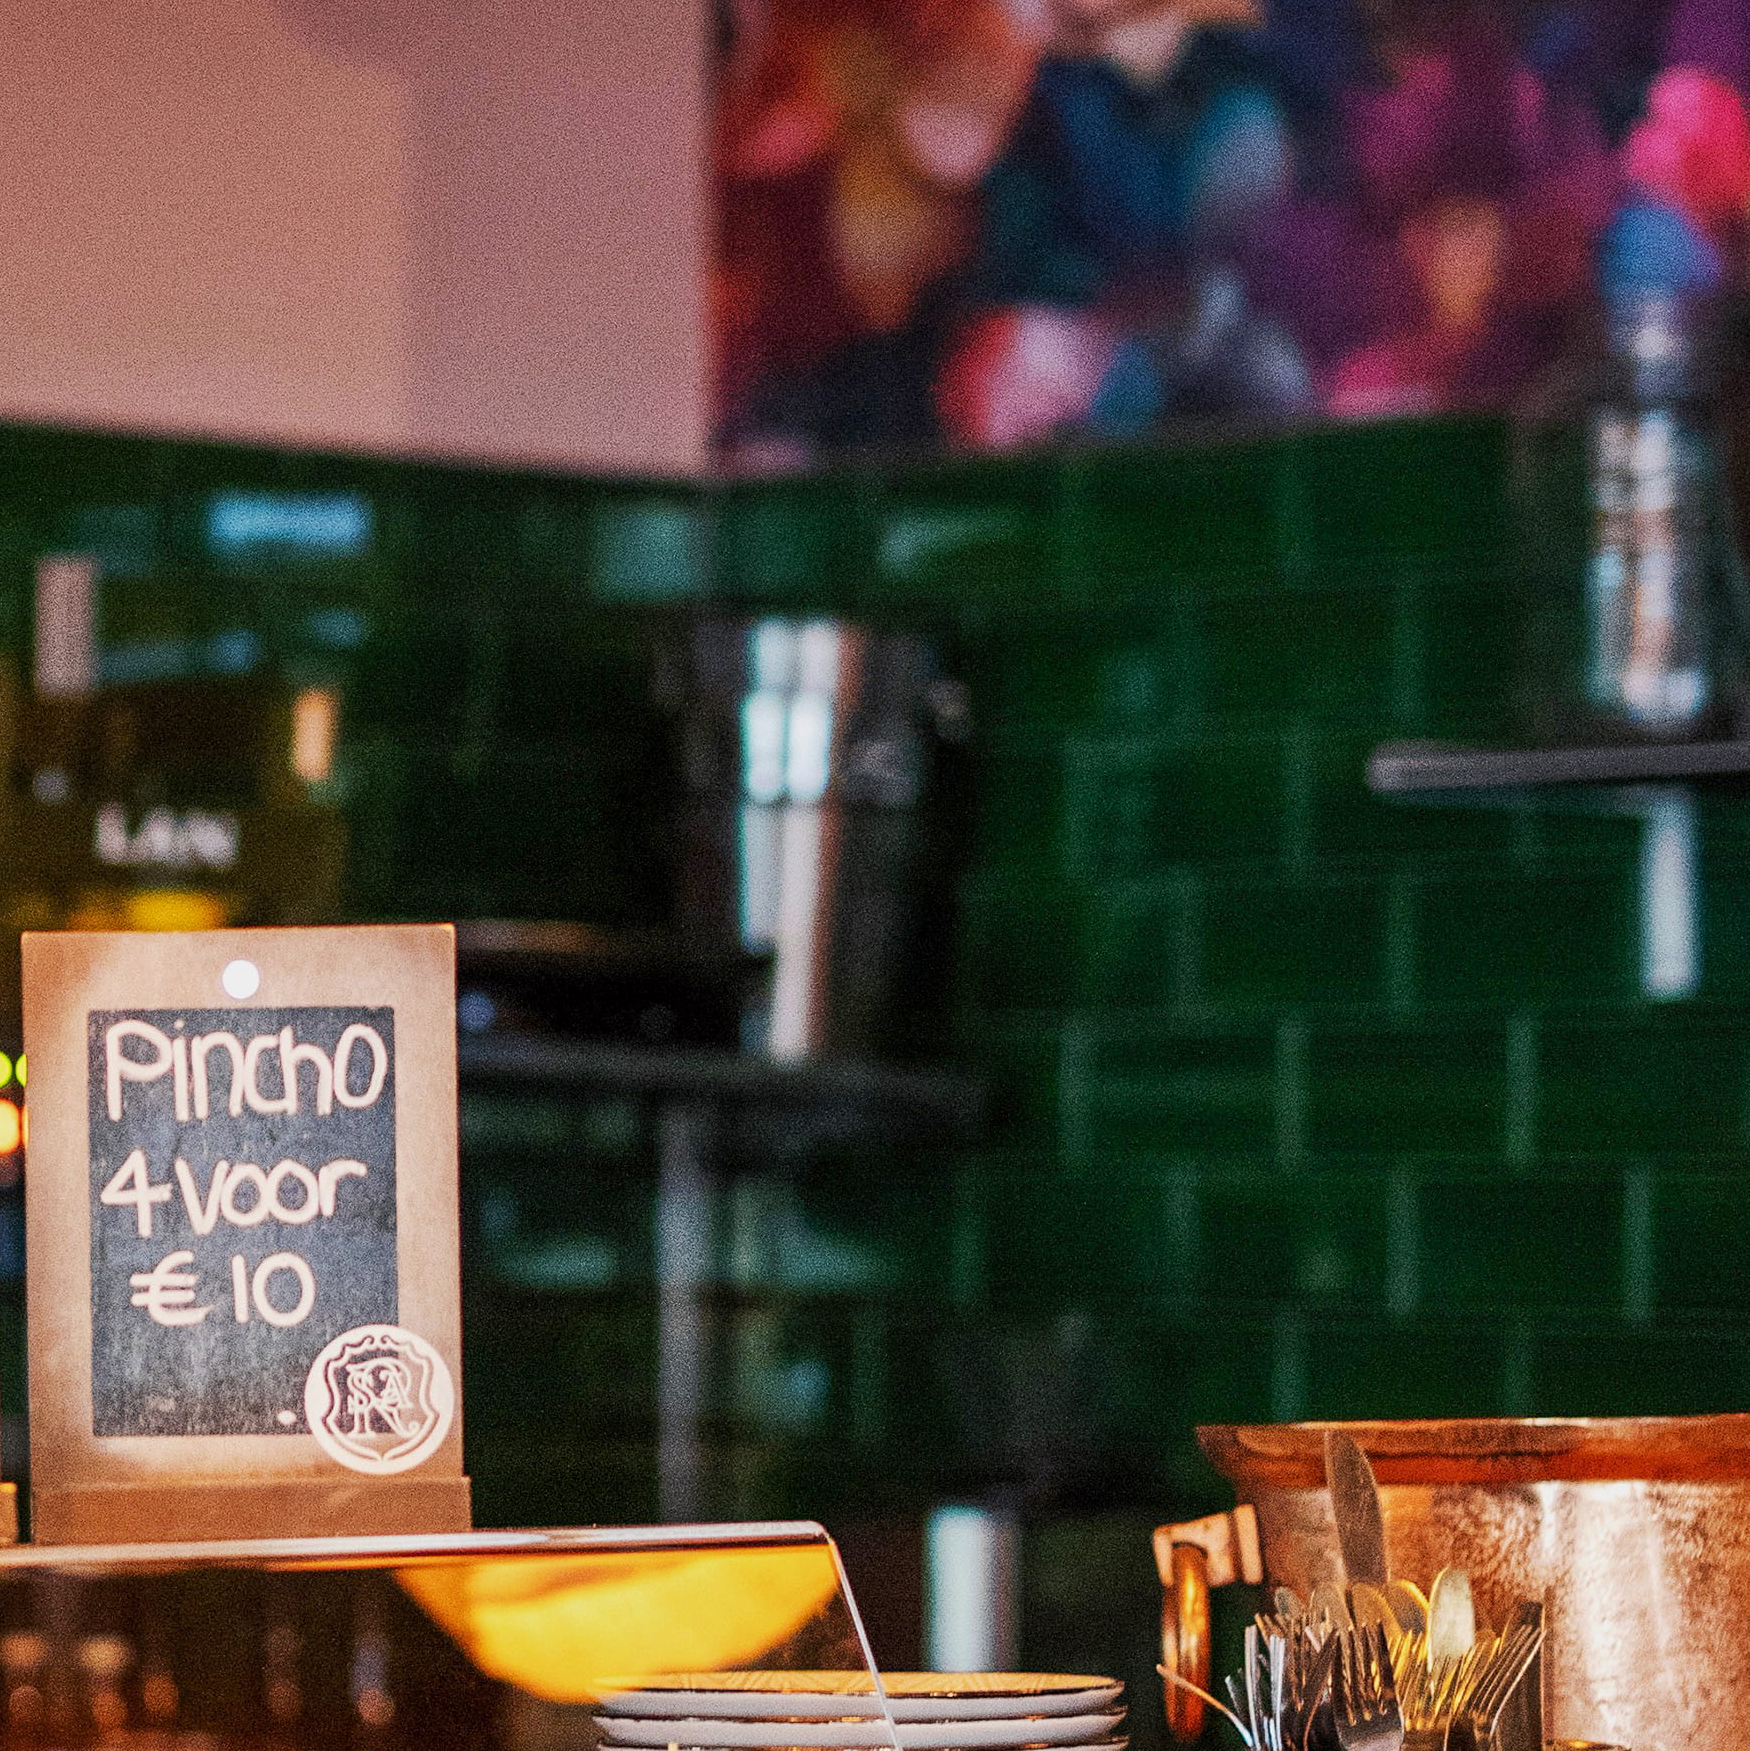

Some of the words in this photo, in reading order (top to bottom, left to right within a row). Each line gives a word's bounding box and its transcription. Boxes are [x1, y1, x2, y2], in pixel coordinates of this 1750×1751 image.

[100, 1149, 173, 1239] 4
[129, 1251, 208, 1328] €
[232, 1252, 316, 1329] 10
